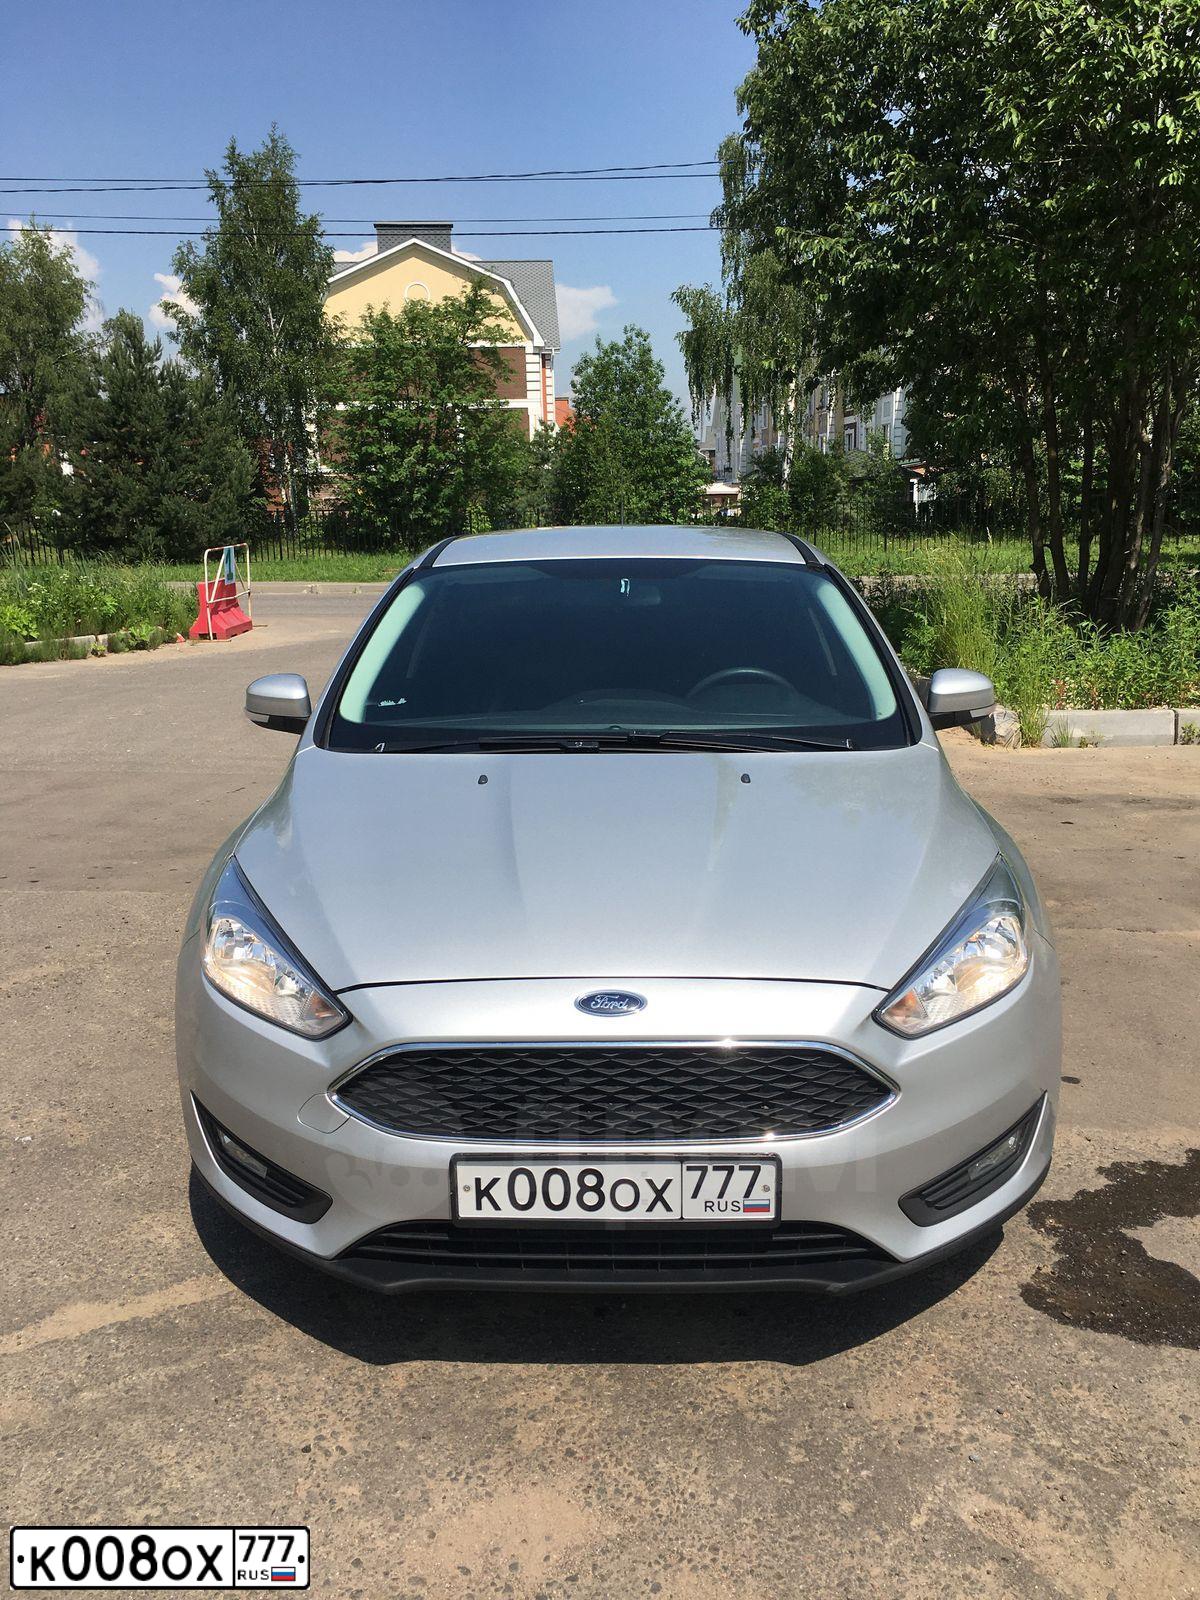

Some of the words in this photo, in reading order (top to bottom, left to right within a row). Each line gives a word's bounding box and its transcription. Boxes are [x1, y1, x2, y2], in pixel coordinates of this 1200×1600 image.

[590, 994, 629, 1010] Ford
[685, 1165, 762, 1199] 777
[704, 1200, 741, 1213] RUS
